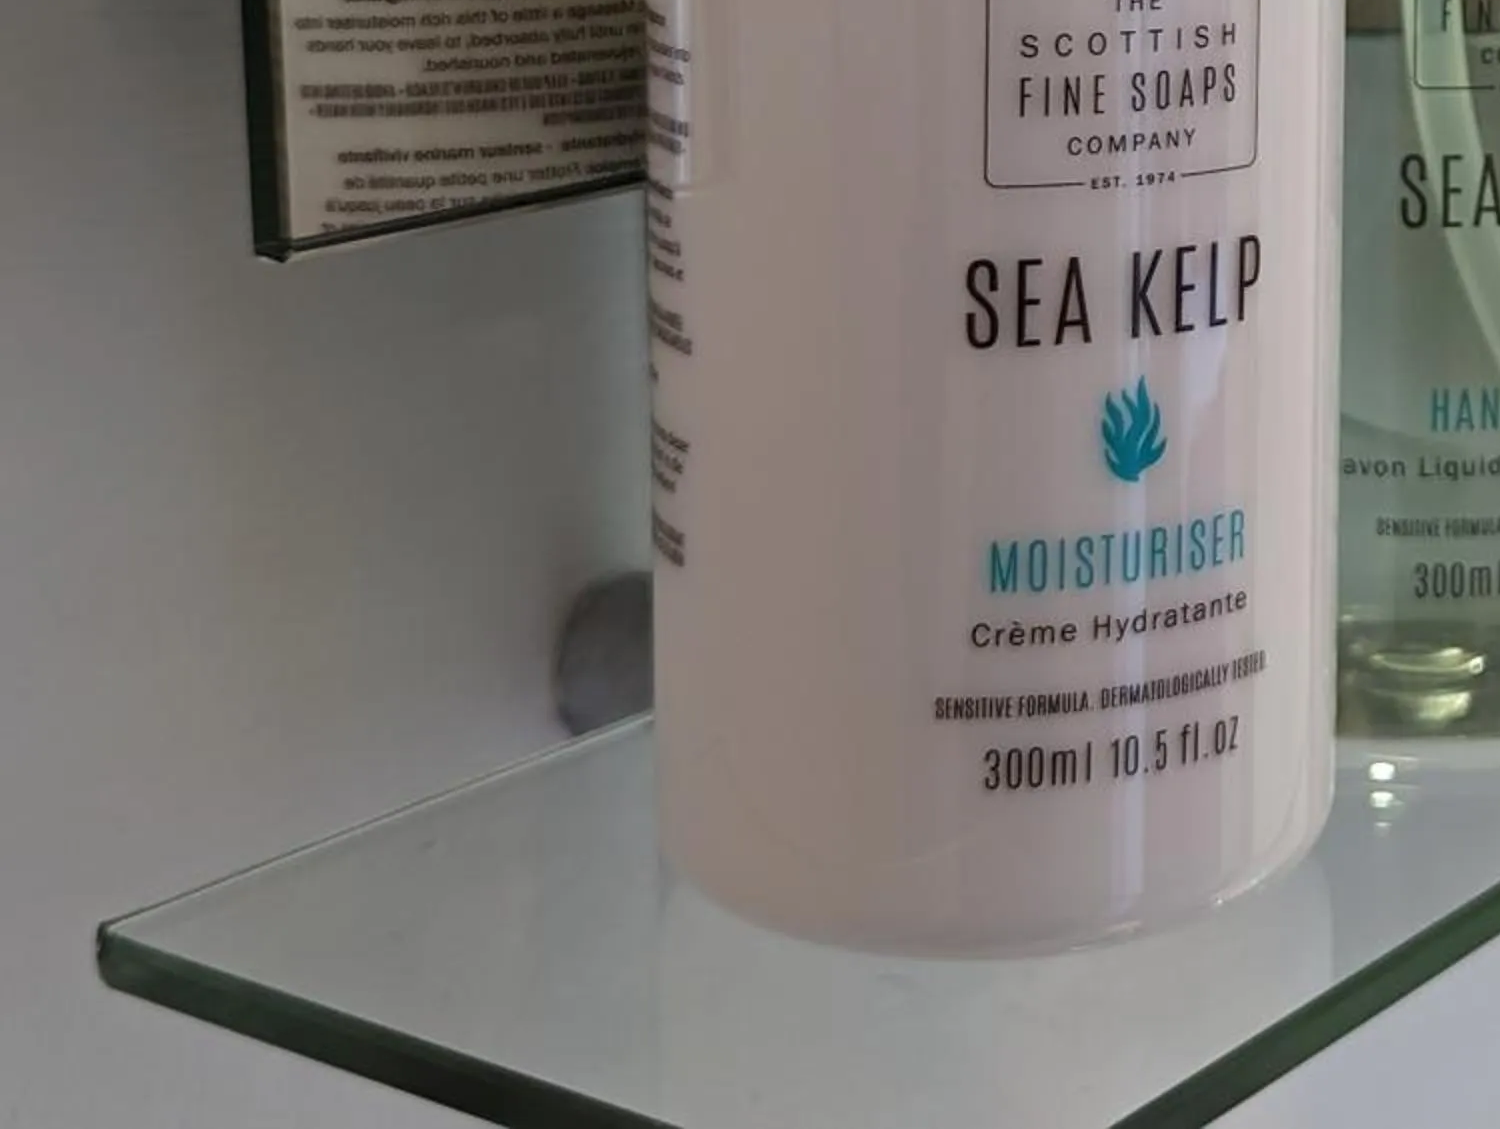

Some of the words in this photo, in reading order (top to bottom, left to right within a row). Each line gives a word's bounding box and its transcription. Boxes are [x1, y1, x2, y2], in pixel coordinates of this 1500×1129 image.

[1018, 22, 1236, 58] SCOTTISH
[1018, 74, 1106, 118] FINE
[1131, 63, 1236, 112] SOAPS
[1067, 128, 1197, 156] COMPANY
[1090, 176, 1127, 190] EST.
[1136, 172, 1176, 186] 1974
[965, 256, 1092, 350] SEA
[1130, 234, 1261, 340] KELP
[1342, 456, 1406, 477] avon
[989, 509, 1245, 593] MOISTURISER
[971, 619, 1078, 648] Crème
[1093, 589, 1248, 642] Hydratante
[934, 695, 1014, 720] SENSITIVE
[1100, 662, 1230, 710] DERMATOLOGICALLY
[983, 741, 1092, 791] 300ml
[1110, 729, 1168, 779] 10.5
